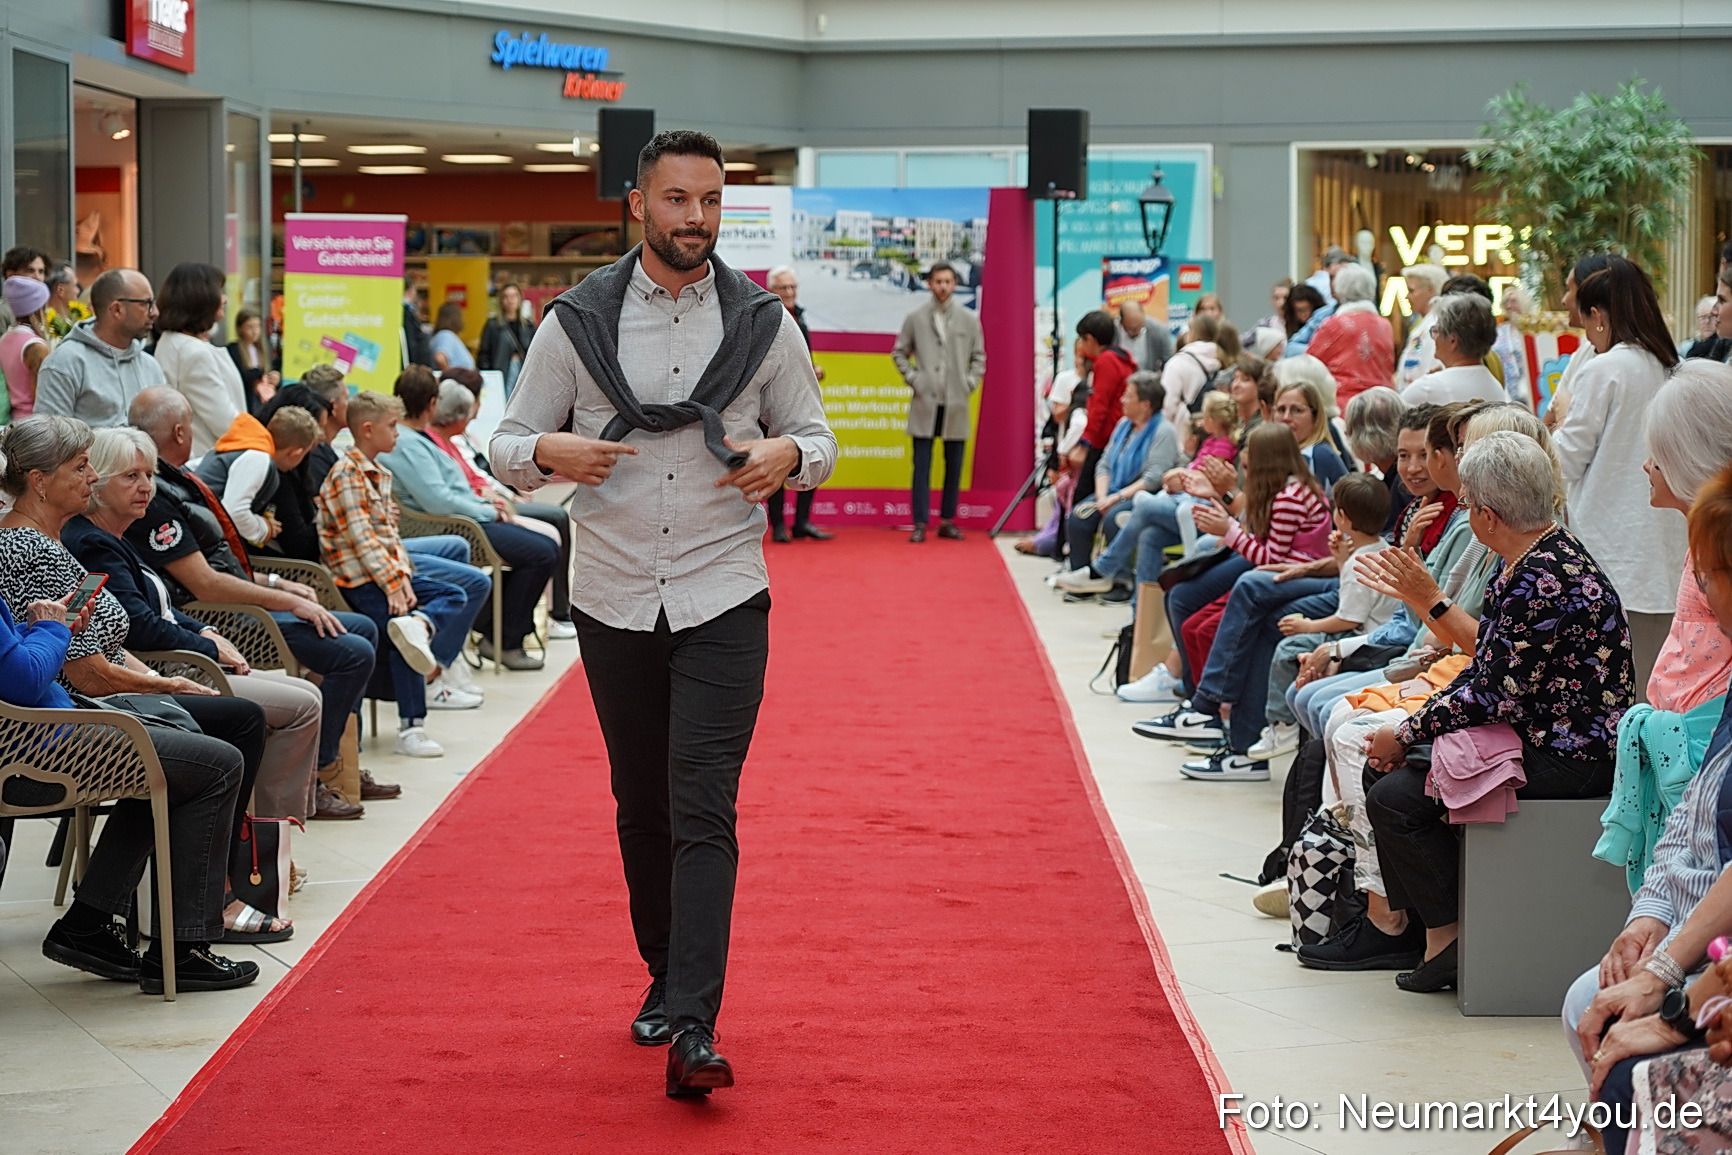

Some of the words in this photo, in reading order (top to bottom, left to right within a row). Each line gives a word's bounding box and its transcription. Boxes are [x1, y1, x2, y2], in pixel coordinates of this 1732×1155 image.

[492, 30, 609, 71] Spielwaren
[719, 227, 775, 239] erMarkt
[292, 236, 372, 251] Verschenken
[373, 236, 394, 251] Sie
[317, 251, 394, 267] Gutscheine!
[303, 311, 384, 328] Gutscheine
[845, 401, 900, 414] Workout
[827, 417, 889, 430] umurlaub
